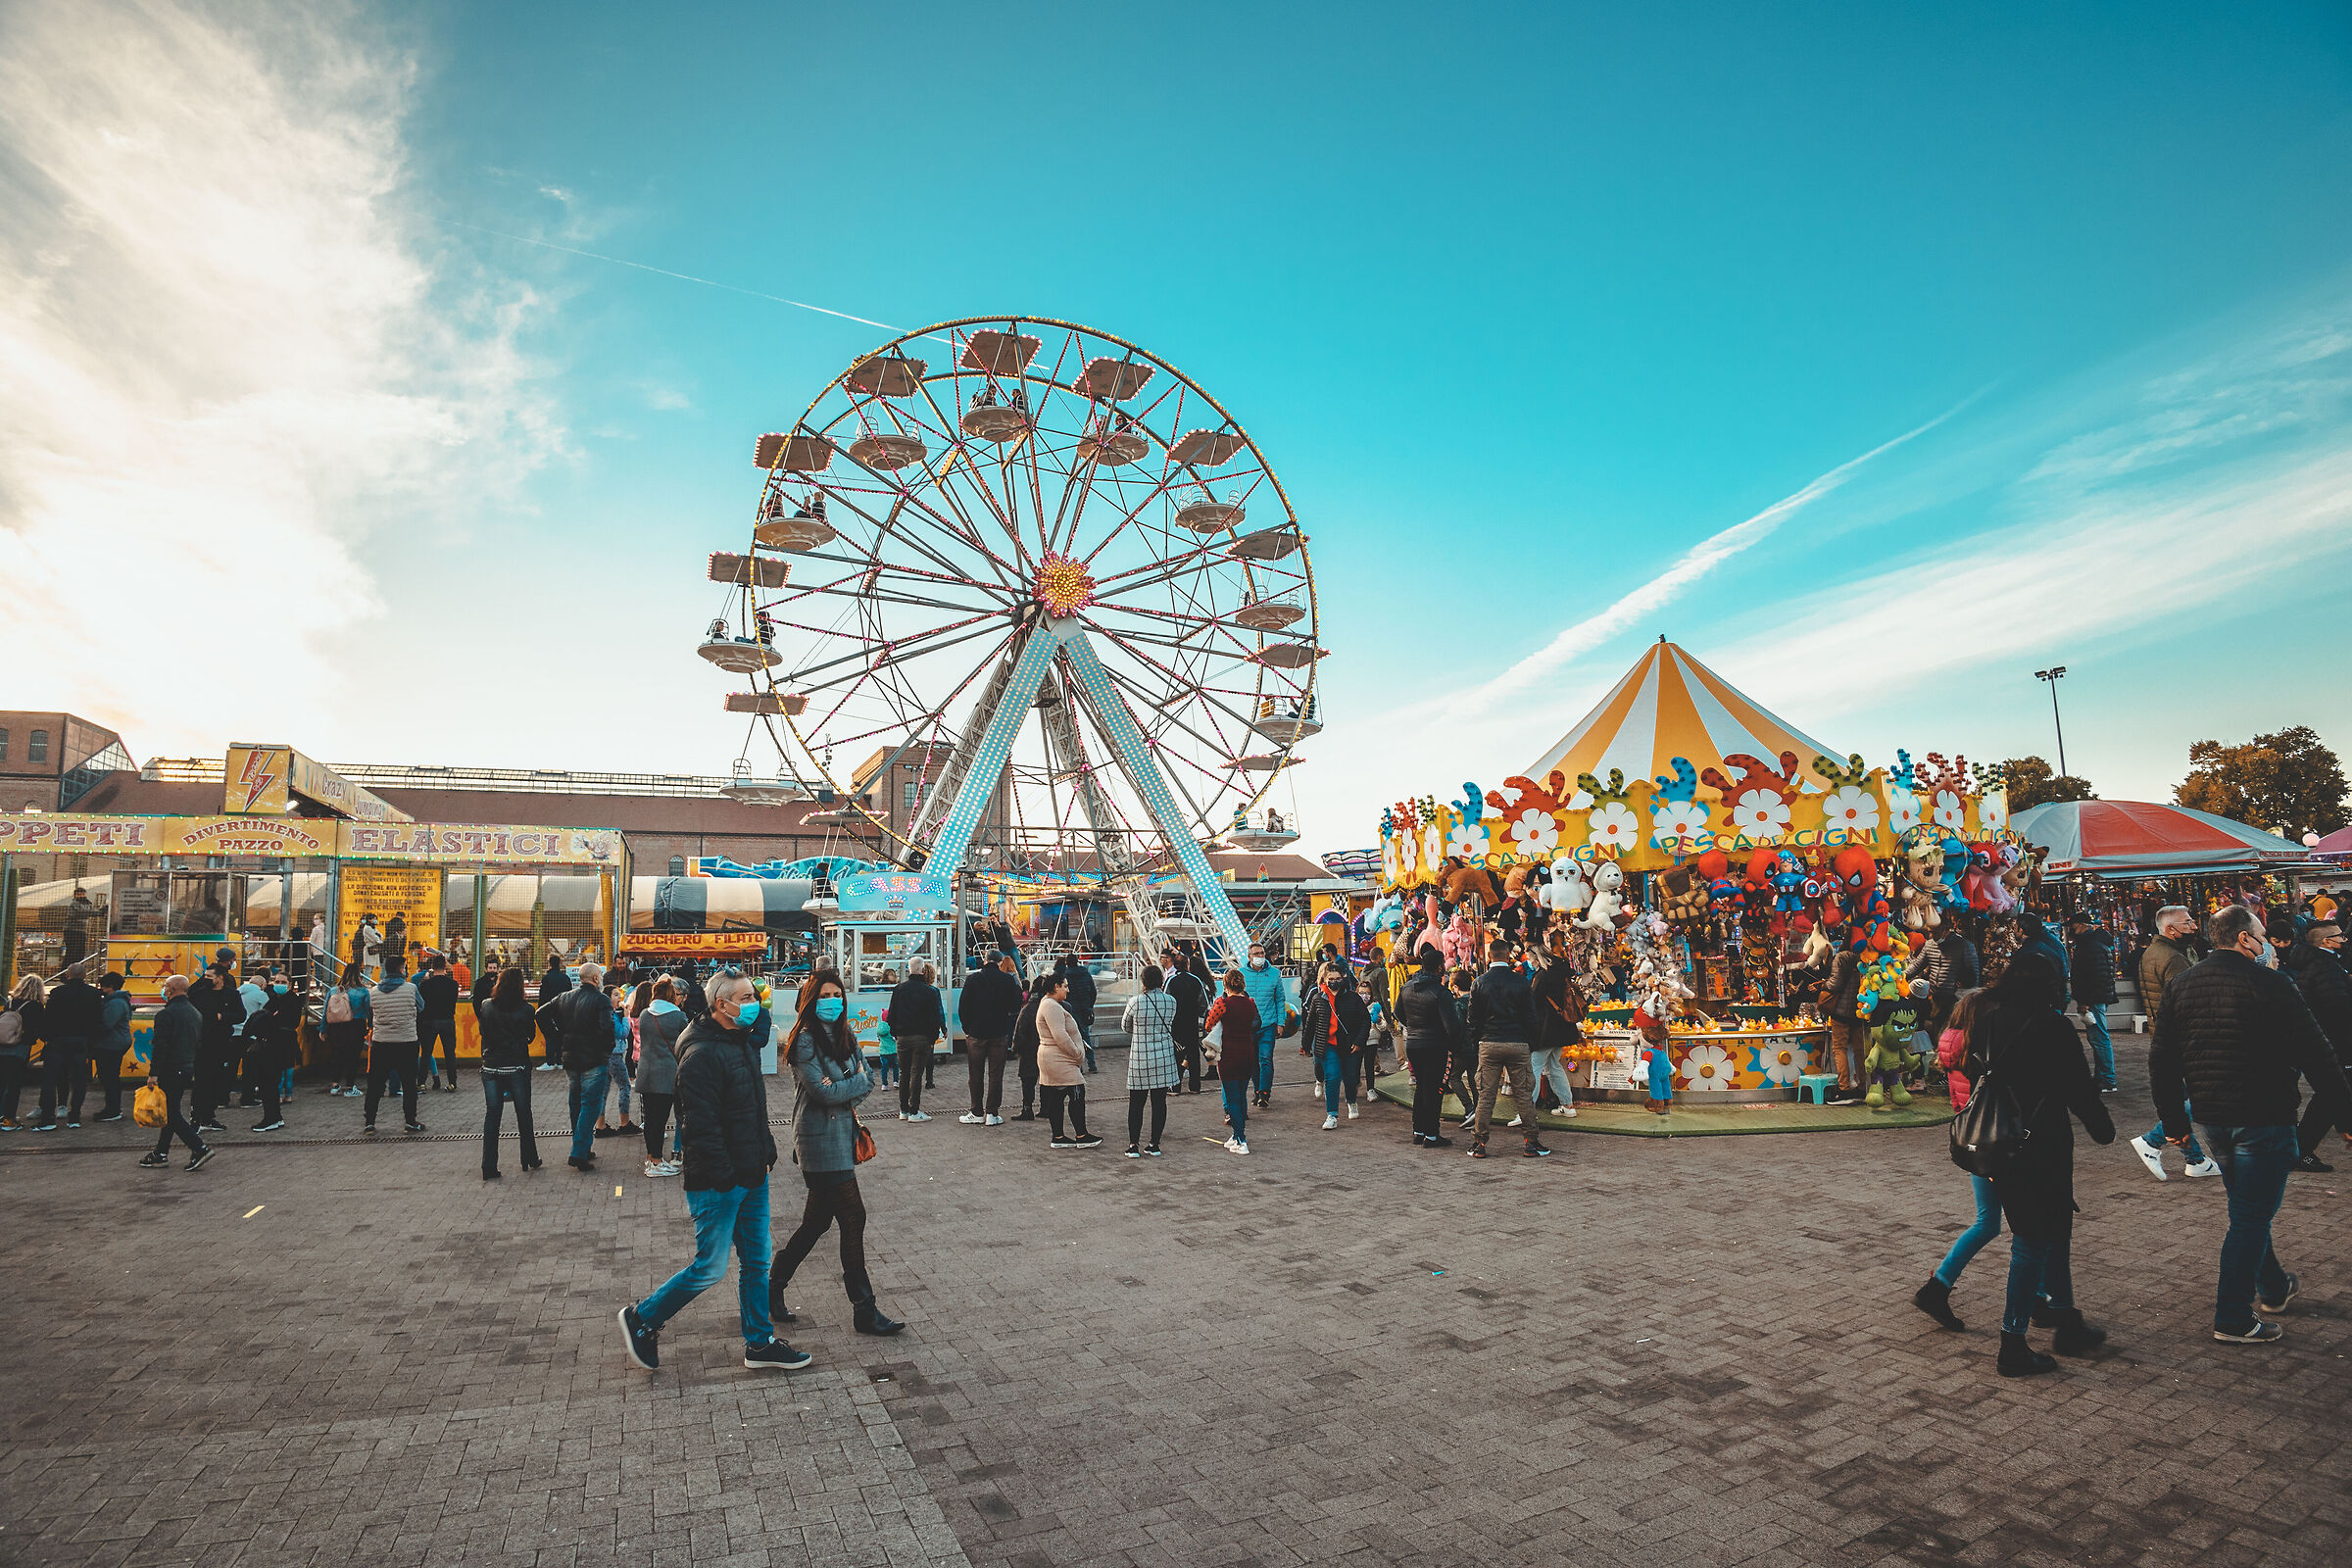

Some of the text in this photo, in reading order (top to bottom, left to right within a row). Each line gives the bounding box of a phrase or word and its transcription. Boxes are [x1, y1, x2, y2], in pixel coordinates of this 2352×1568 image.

[321, 771, 348, 804] Crazy
[355, 794, 382, 821] Jumping
[182, 819, 320, 851] DIVERTIMENTO
[218, 838, 284, 852] PAZZO
[350, 827, 562, 857] ELASTICI
[1660, 826, 1880, 855] PESCA DEI CIGNI
[1458, 852, 1516, 870] ESCA
[845, 875, 946, 898] CASSA
[626, 933, 764, 945] ZUCCHERO FILATO
